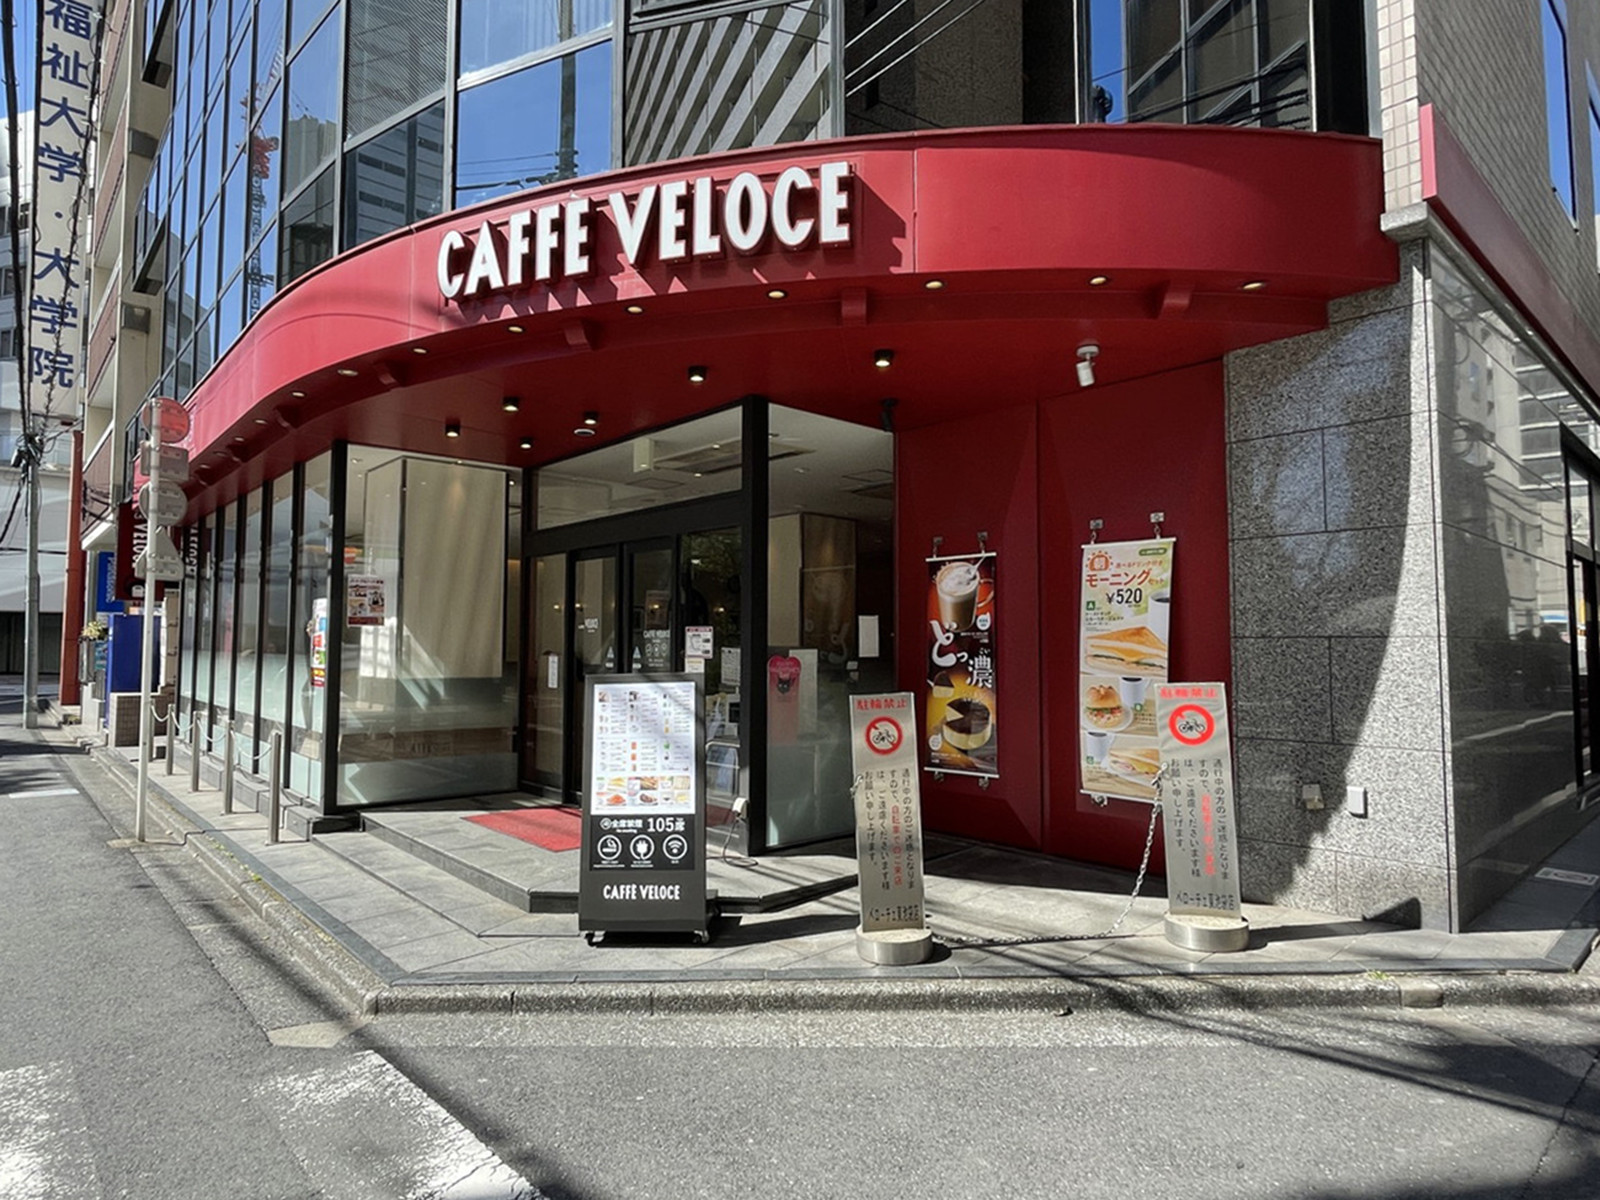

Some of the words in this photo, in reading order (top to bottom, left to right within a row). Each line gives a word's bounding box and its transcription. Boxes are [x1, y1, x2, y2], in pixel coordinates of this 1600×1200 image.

[608, 161, 851, 265] VELOCE
[856, 698, 908, 711] 駐輪禁止
[639, 885, 681, 900] VELOCE
